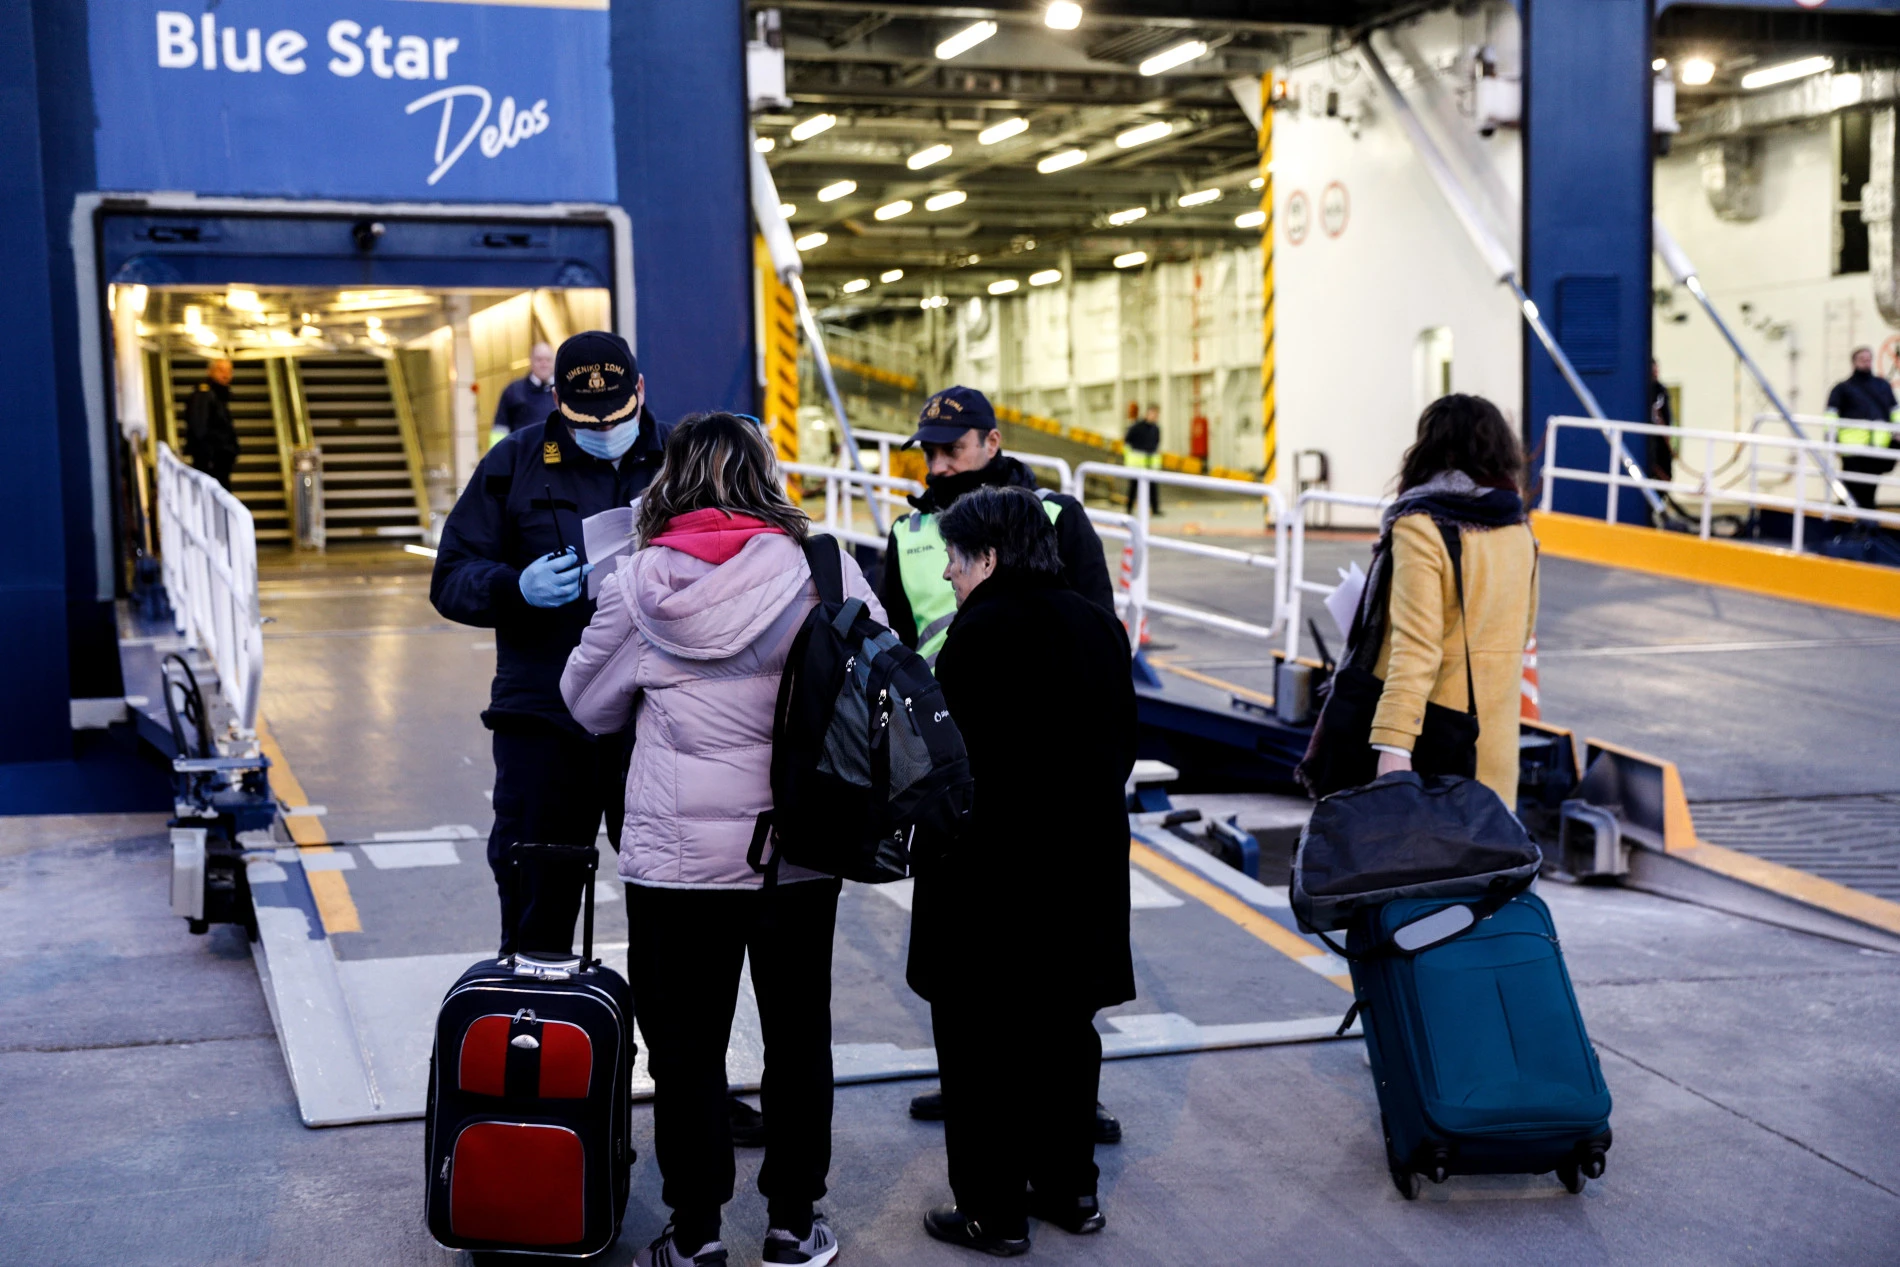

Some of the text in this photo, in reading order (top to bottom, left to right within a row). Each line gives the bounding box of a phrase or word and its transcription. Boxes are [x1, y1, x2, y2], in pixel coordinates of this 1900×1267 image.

[156, 10, 459, 80] Blue Star
[405, 84, 550, 185] Delos
